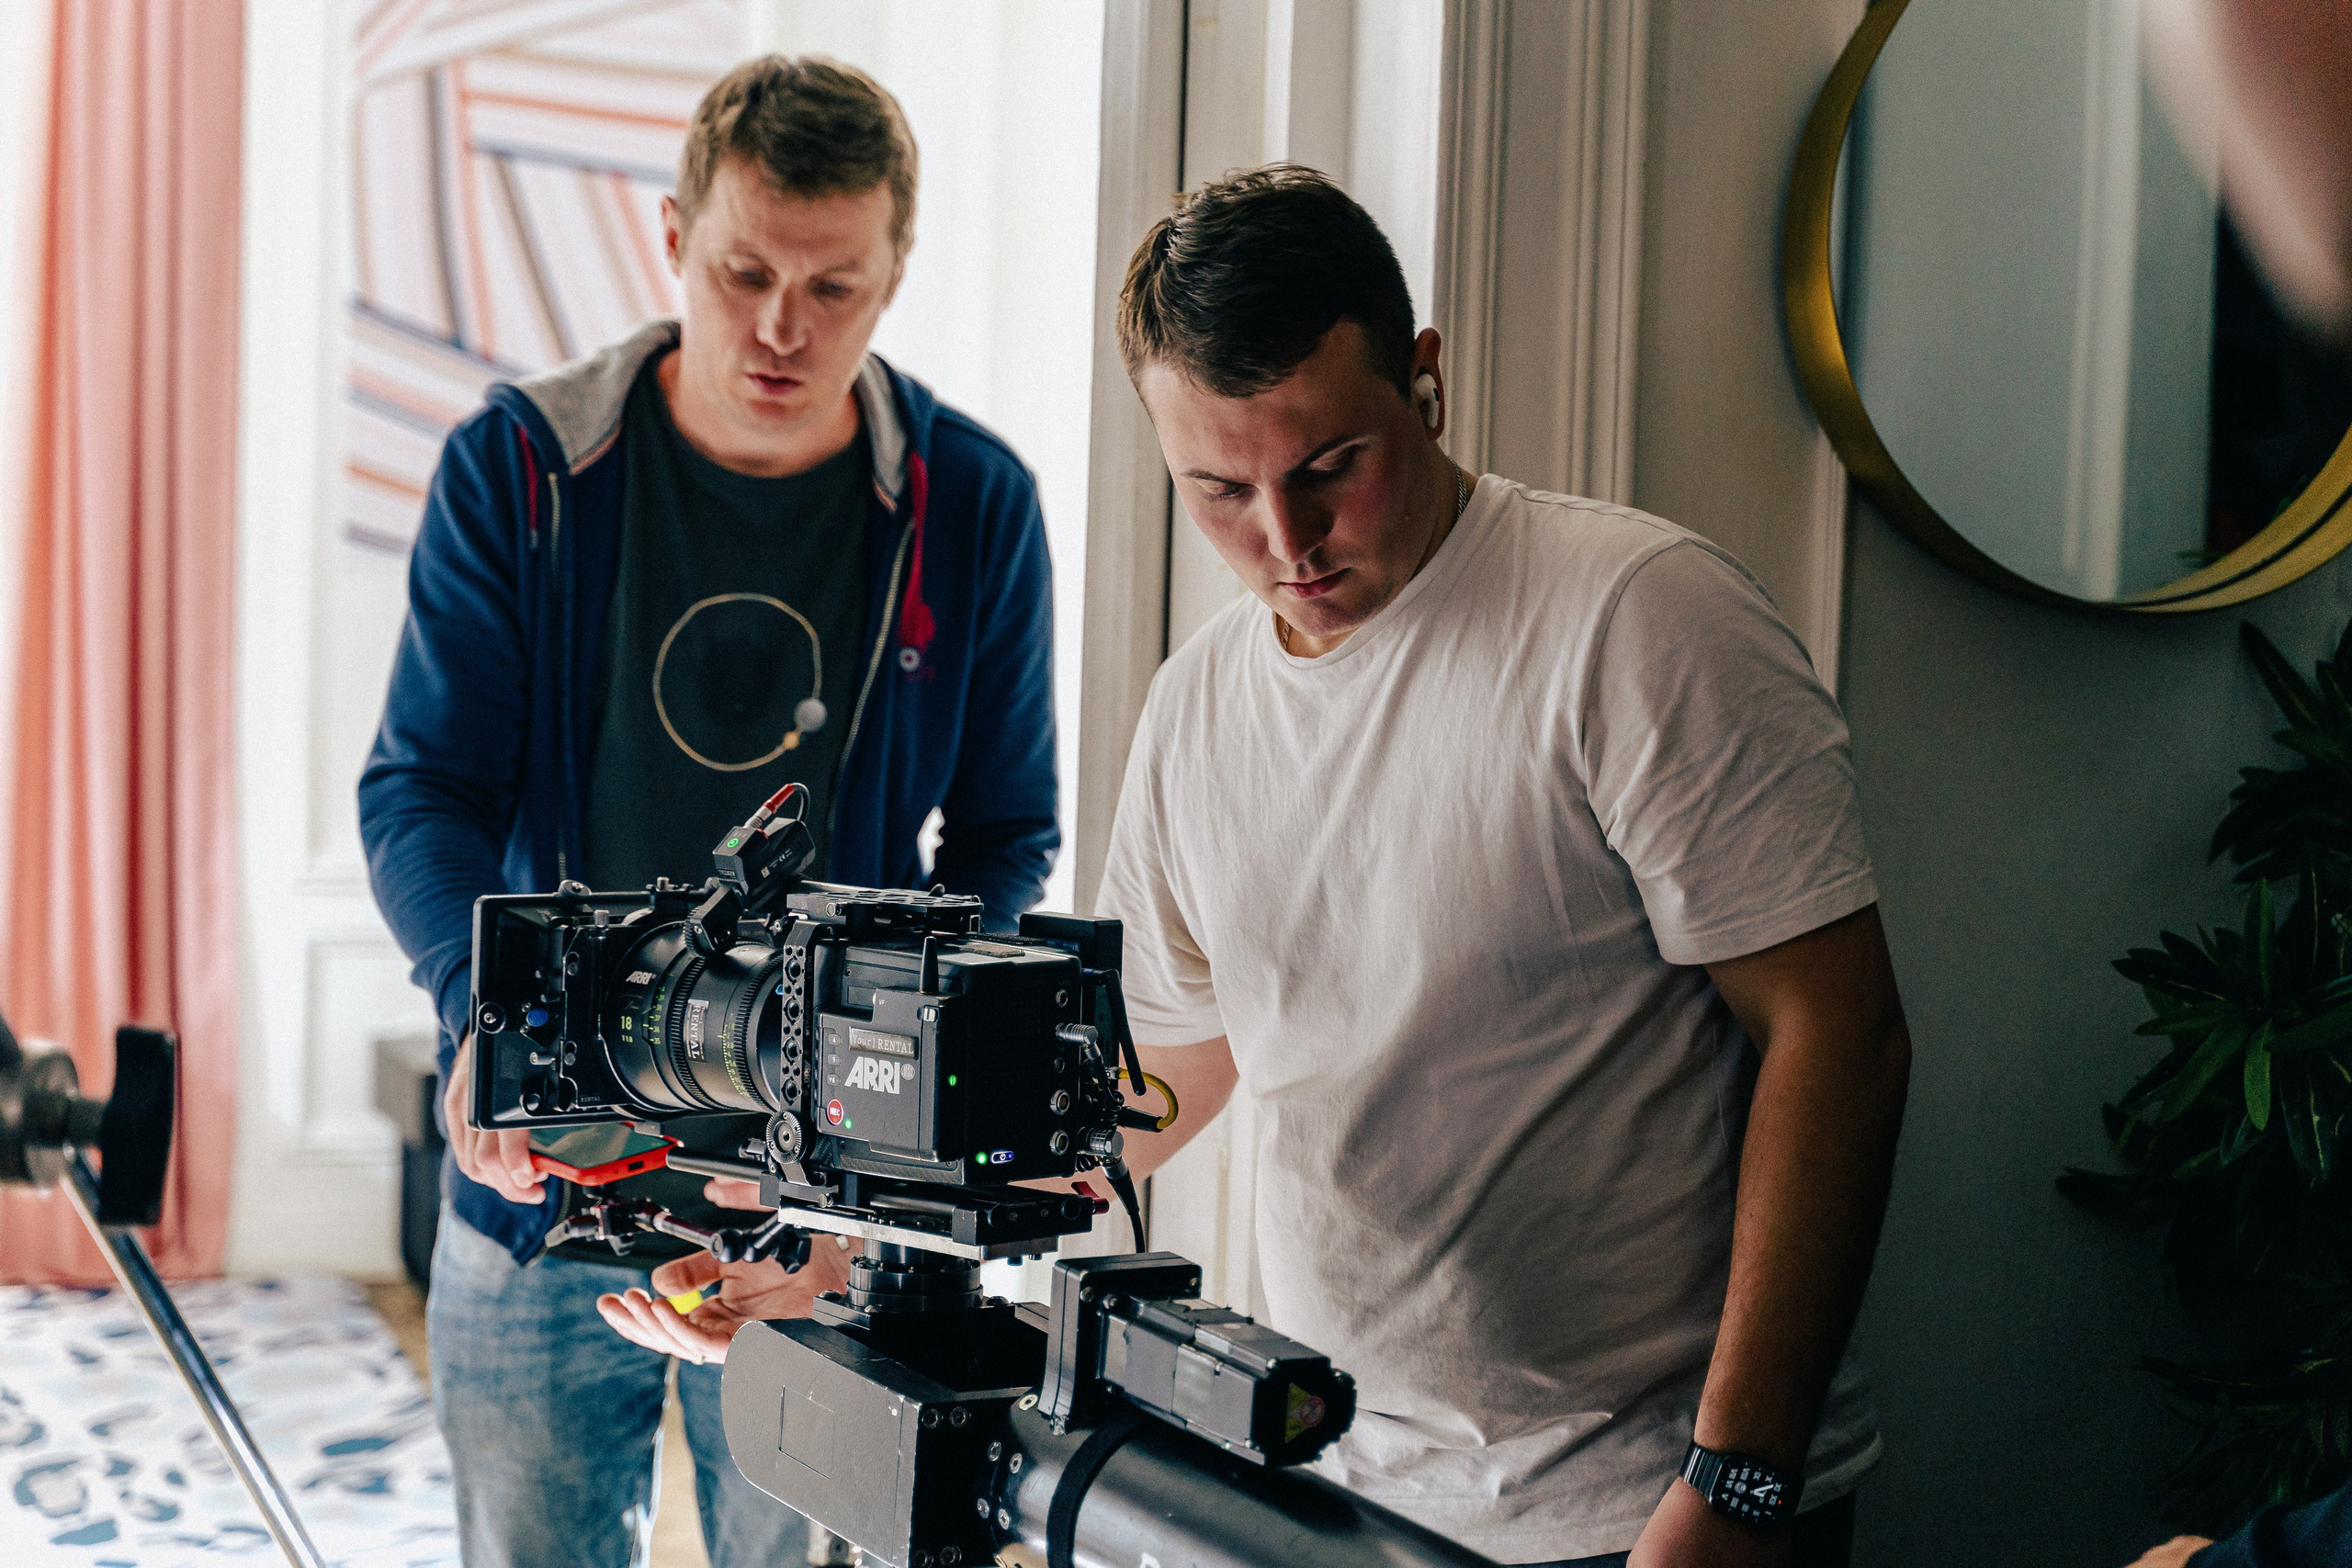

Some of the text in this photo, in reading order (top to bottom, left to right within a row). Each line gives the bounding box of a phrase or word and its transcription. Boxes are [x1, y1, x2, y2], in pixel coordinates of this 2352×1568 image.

[626, 970, 652, 985] ARRI
[621, 1015, 632, 1031] 18
[690, 1005, 701, 1059] RENTAL
[877, 1038, 914, 1055] RENTAL
[844, 1055, 900, 1095] ARRI
[830, 1107, 840, 1117] REC
